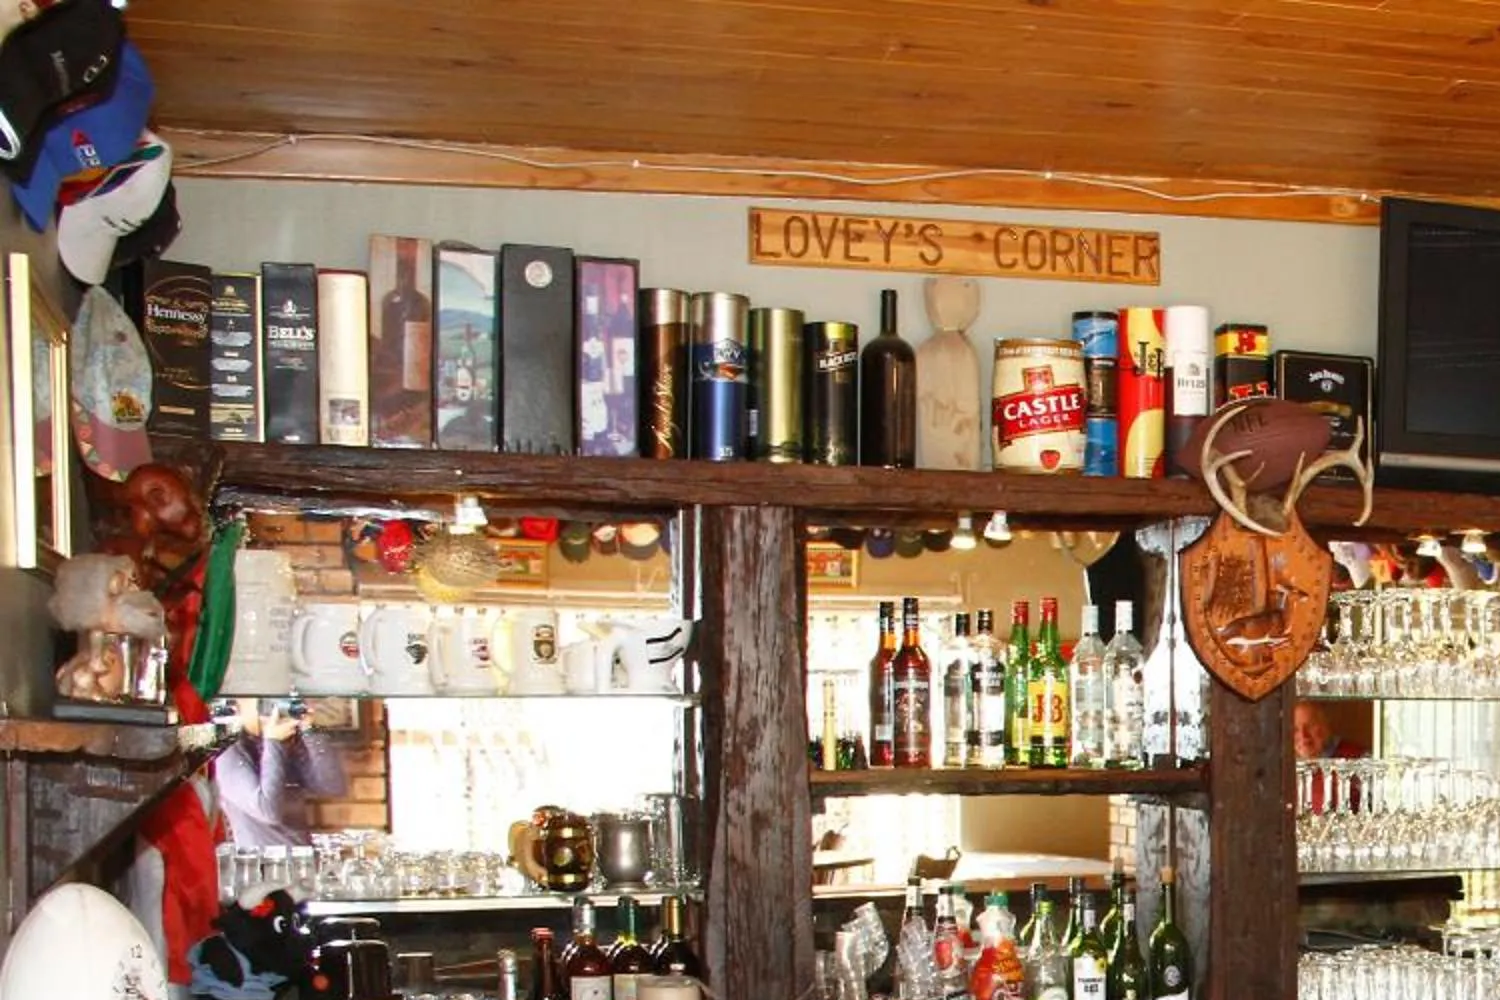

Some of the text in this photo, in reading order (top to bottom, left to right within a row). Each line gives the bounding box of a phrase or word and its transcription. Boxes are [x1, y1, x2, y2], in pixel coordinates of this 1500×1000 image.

[751, 211, 1160, 278] LOVEY'S CORNER
[147, 303, 207, 324] Hennessy
[1003, 393, 1081, 421] CASTLE
[1019, 413, 1070, 429] LAGER
